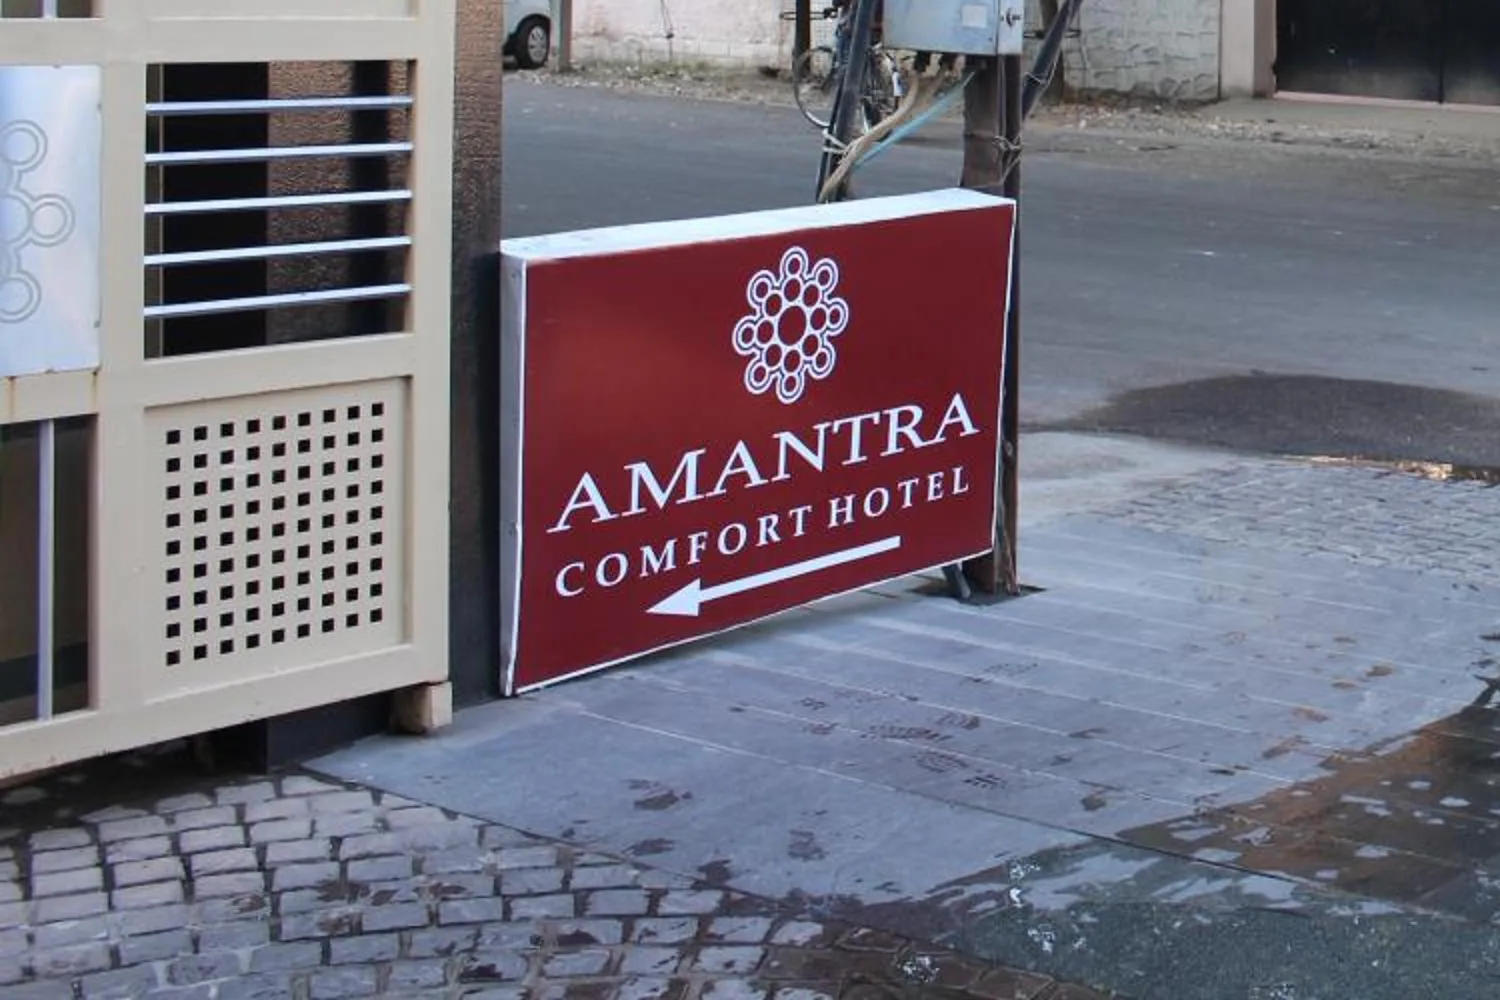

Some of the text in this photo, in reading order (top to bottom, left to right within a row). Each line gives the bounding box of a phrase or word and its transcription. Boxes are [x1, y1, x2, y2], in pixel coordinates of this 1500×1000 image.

[546, 392, 980, 533] AMANTRA
[555, 465, 969, 597] COMFORT HOTEL
